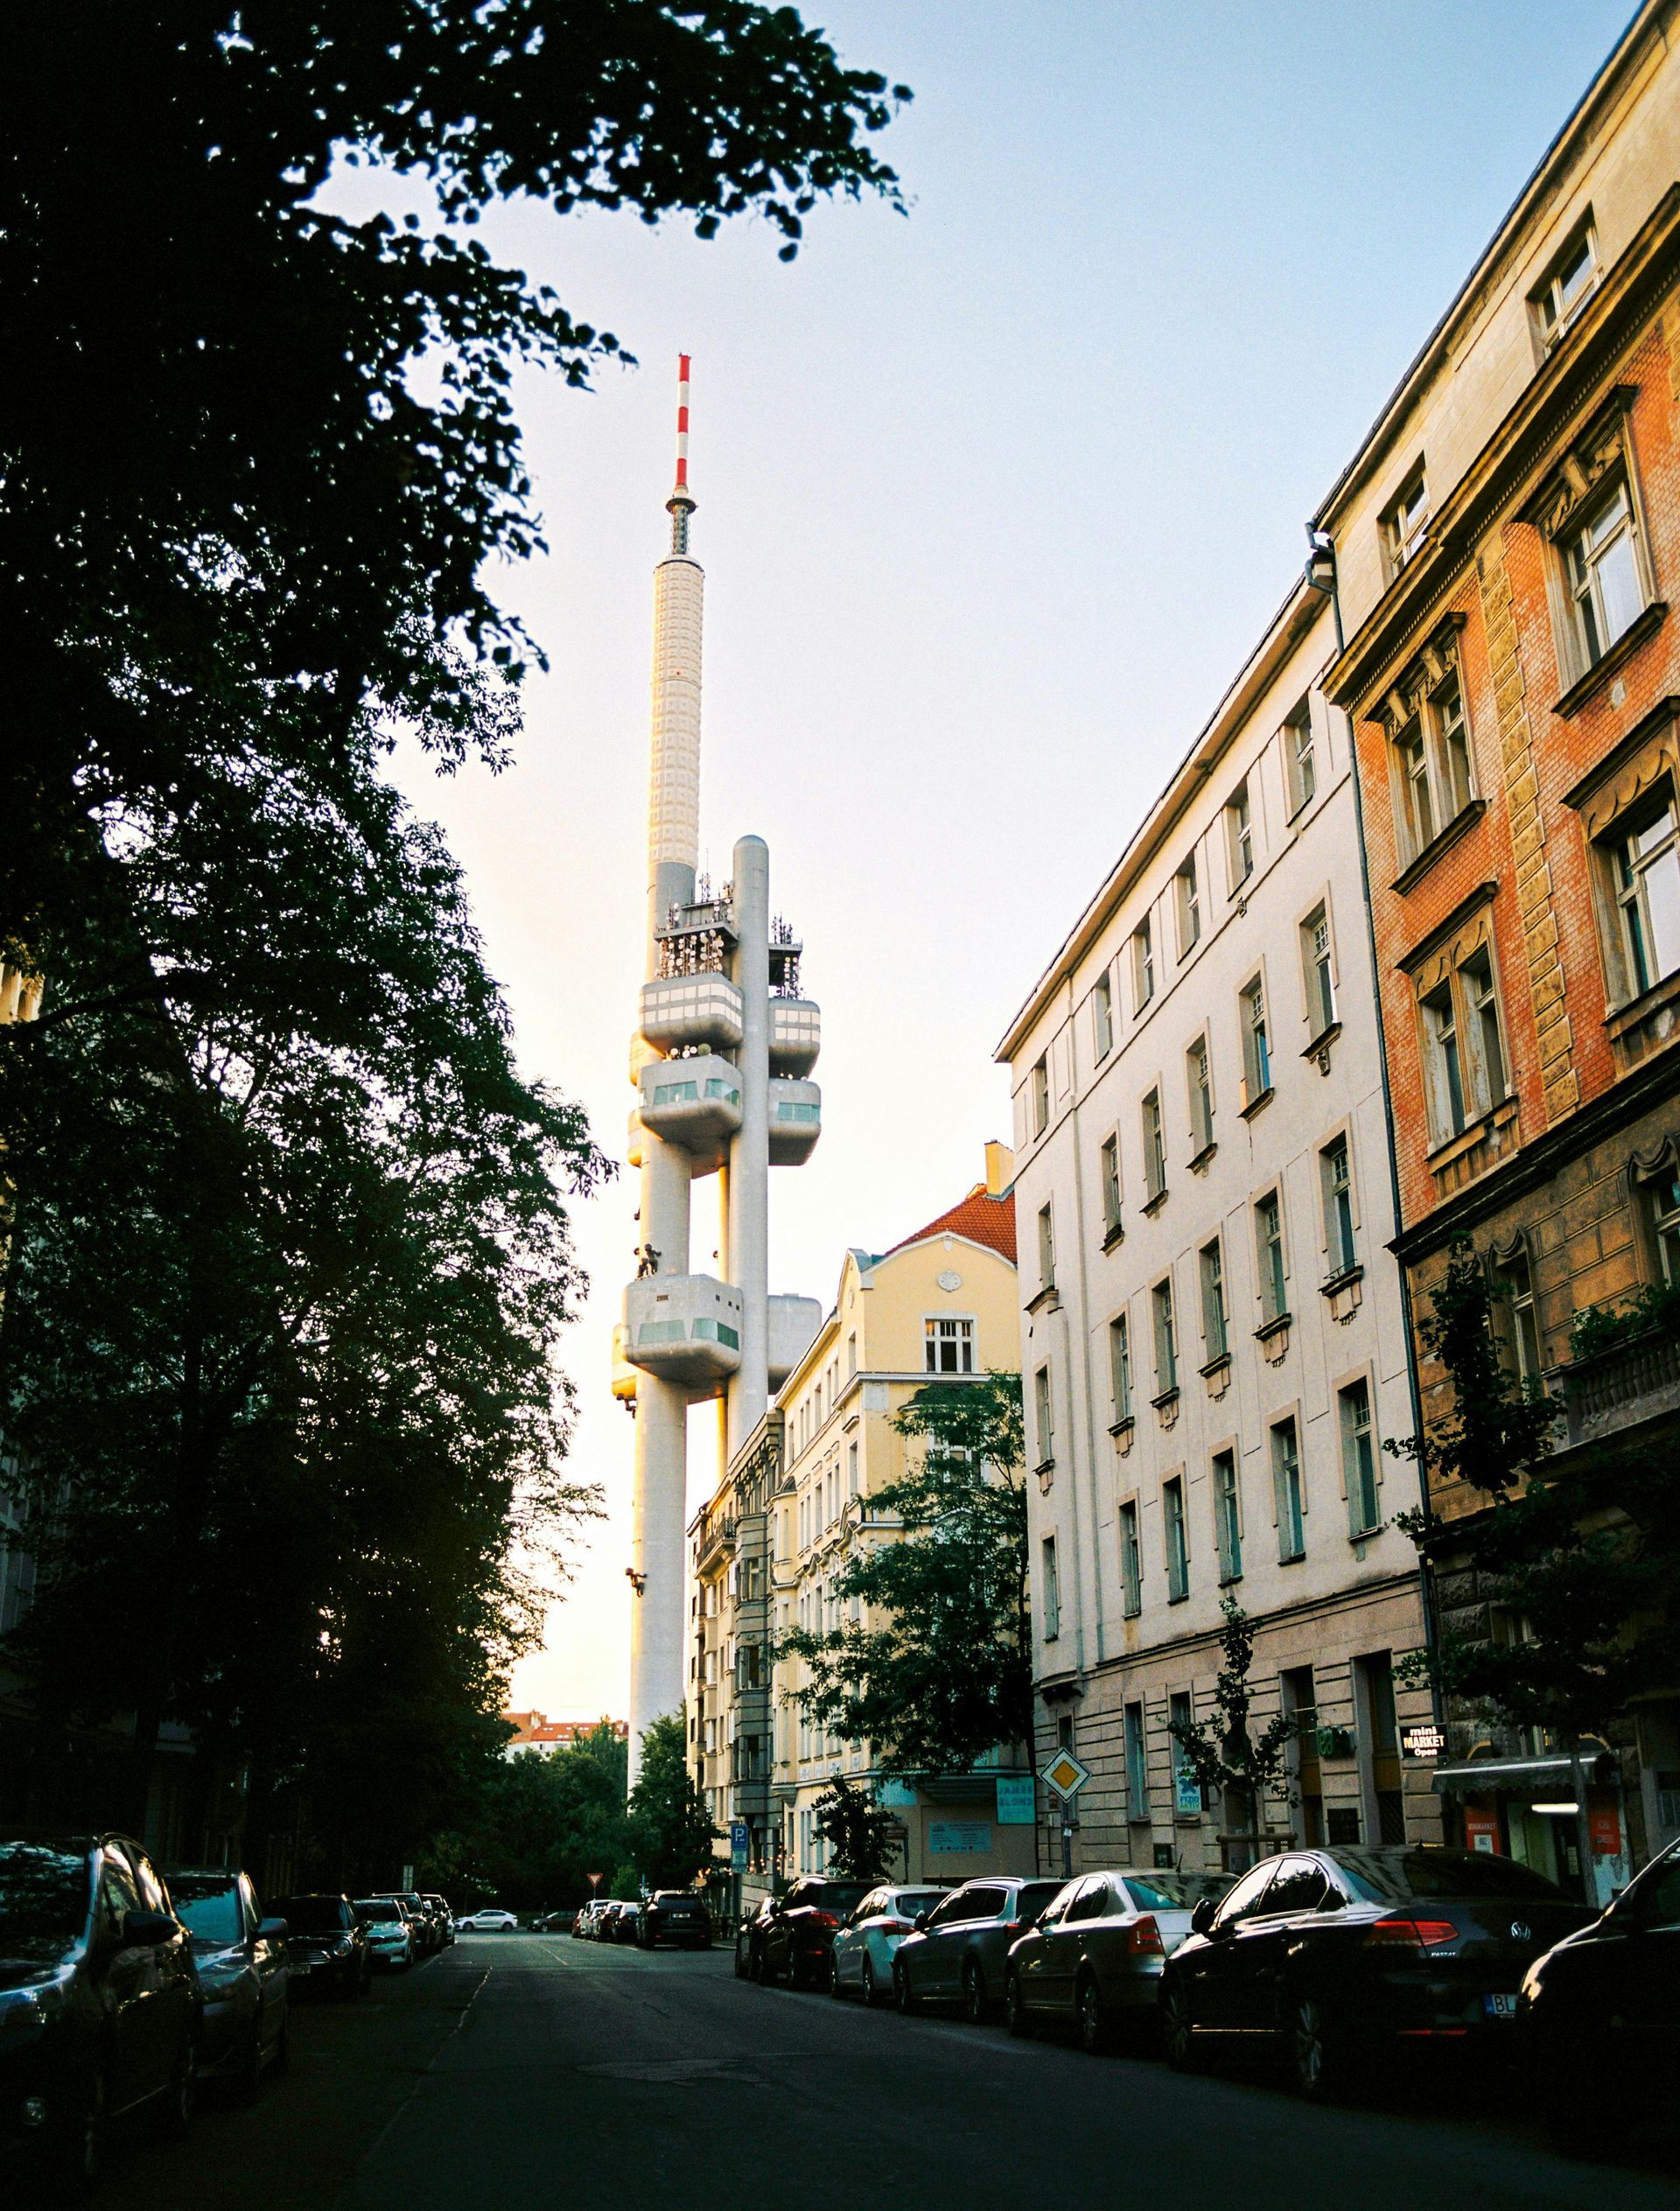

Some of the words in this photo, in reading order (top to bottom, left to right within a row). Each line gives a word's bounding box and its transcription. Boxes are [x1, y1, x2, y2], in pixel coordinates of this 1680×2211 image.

[1410, 1726, 1437, 1736] mini
[1404, 1735, 1444, 1748] MARKET
[1414, 1748, 1438, 1757] Open
[735, 1828, 745, 1842] P
